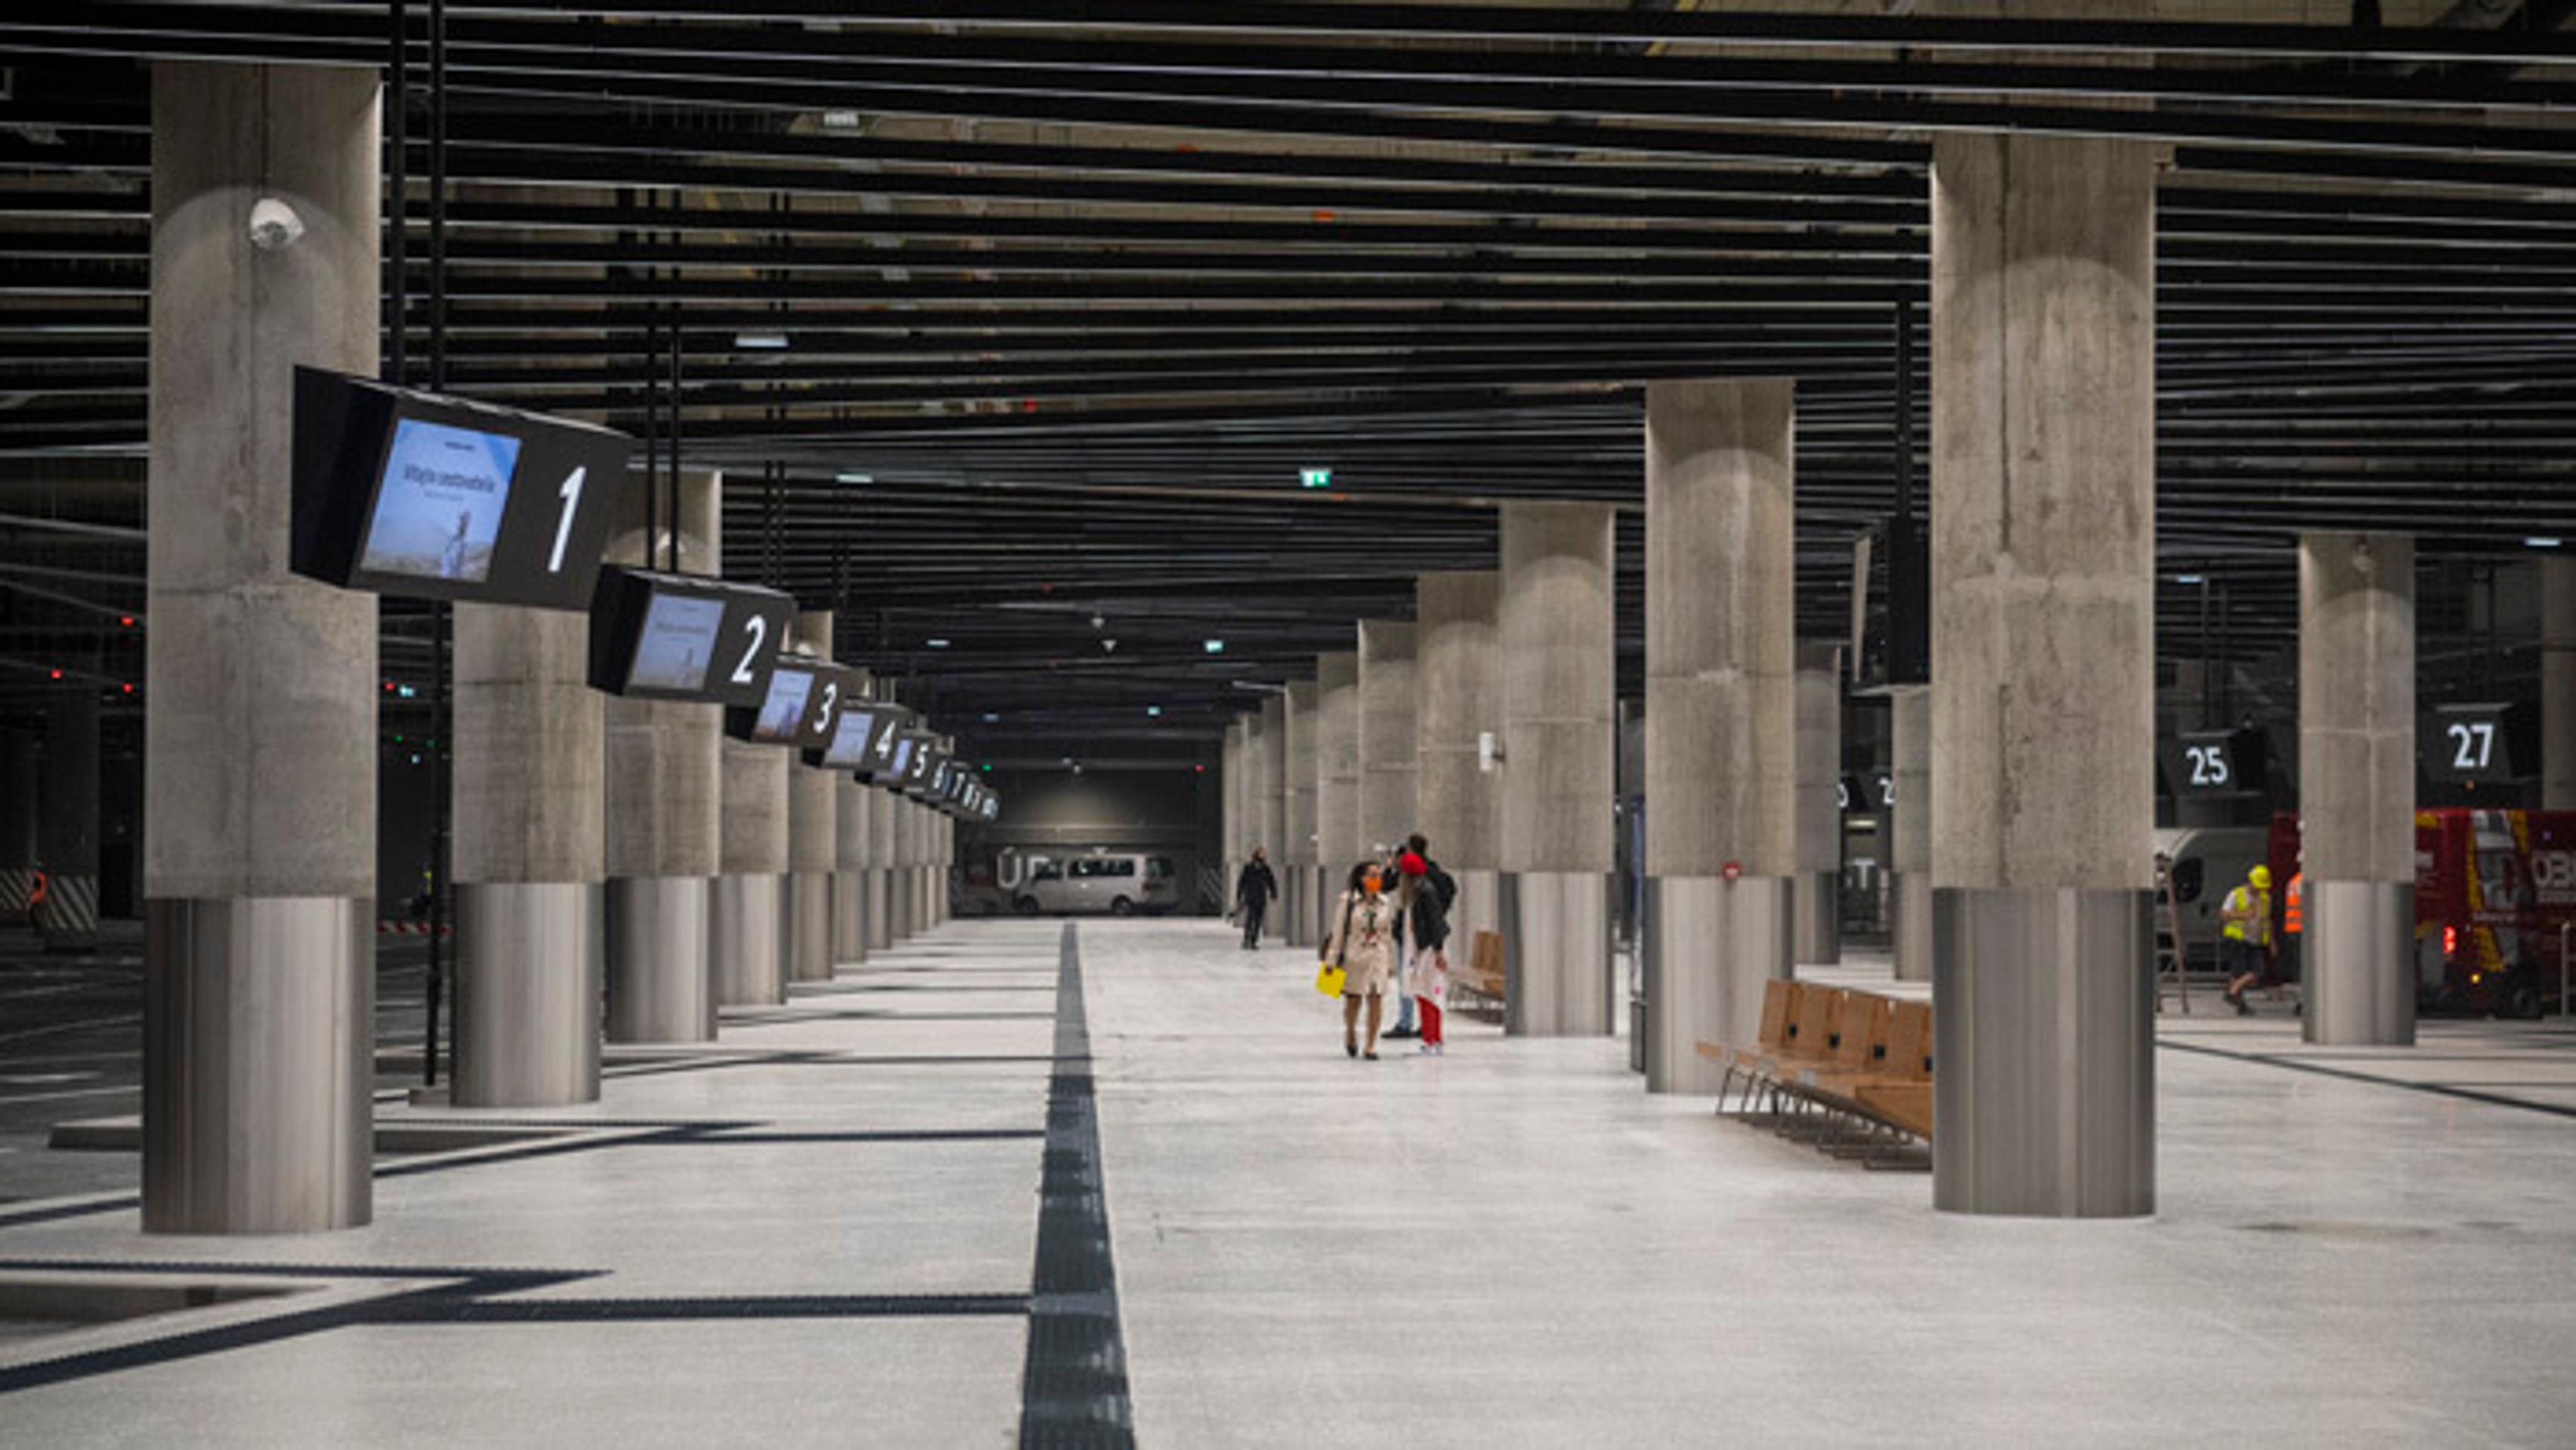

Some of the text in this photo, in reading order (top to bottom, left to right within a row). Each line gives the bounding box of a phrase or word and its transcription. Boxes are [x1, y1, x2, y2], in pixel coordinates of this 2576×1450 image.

[548, 465, 588, 573] 1
[730, 614, 767, 683] 2
[813, 682, 838, 733] 3
[875, 720, 895, 760] 4
[912, 743, 929, 779] 5
[2448, 723, 2494, 768] 27
[2186, 746, 2229, 785] 25
